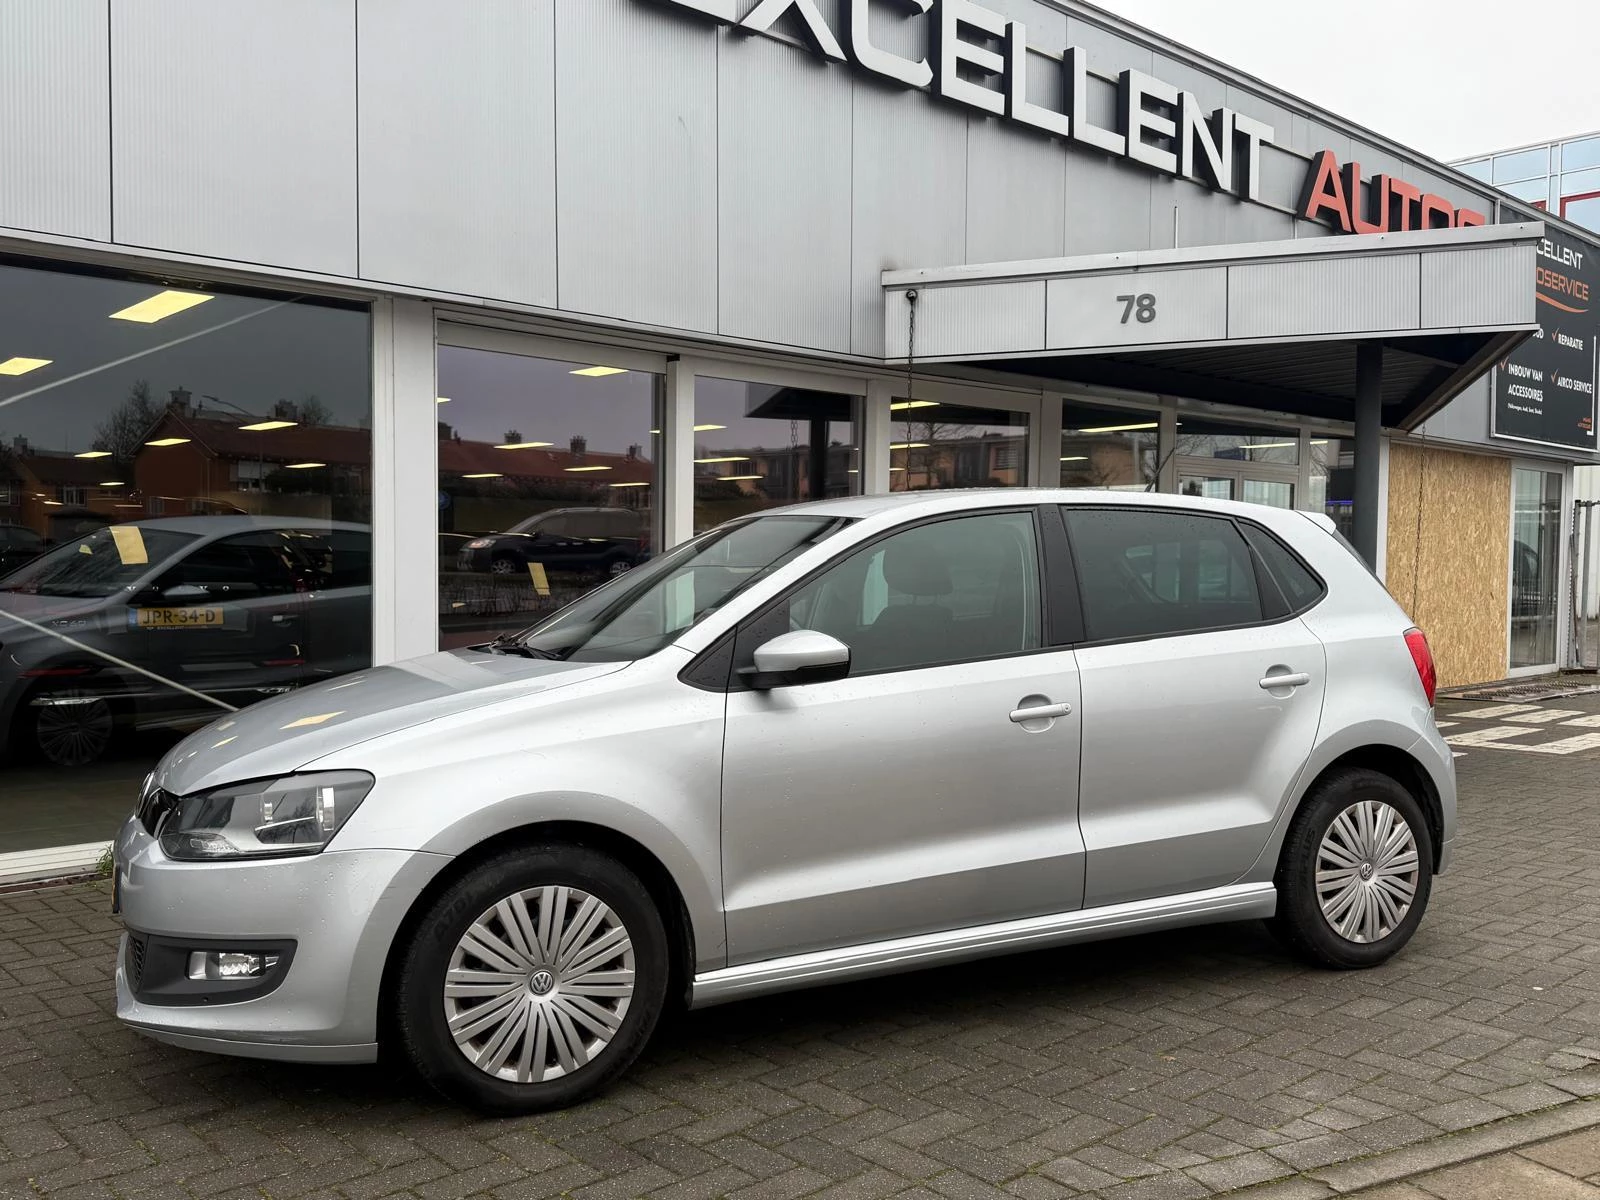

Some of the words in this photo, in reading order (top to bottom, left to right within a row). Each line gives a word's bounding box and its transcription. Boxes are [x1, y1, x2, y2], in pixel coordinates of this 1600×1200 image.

[667, 0, 1275, 201] CELLENT
[1116, 293, 1156, 324] 78
[1558, 333, 1583, 351] REPARATIE
[1508, 363, 1531, 379] INBOUW
[1531, 368, 1543, 382] VAN
[1508, 384, 1543, 402] ACCESSOIRES
[1557, 376, 1573, 390] AIRCO
[1573, 379, 1592, 394] SERVICE
[142, 609, 216, 625] JPR-34-D
